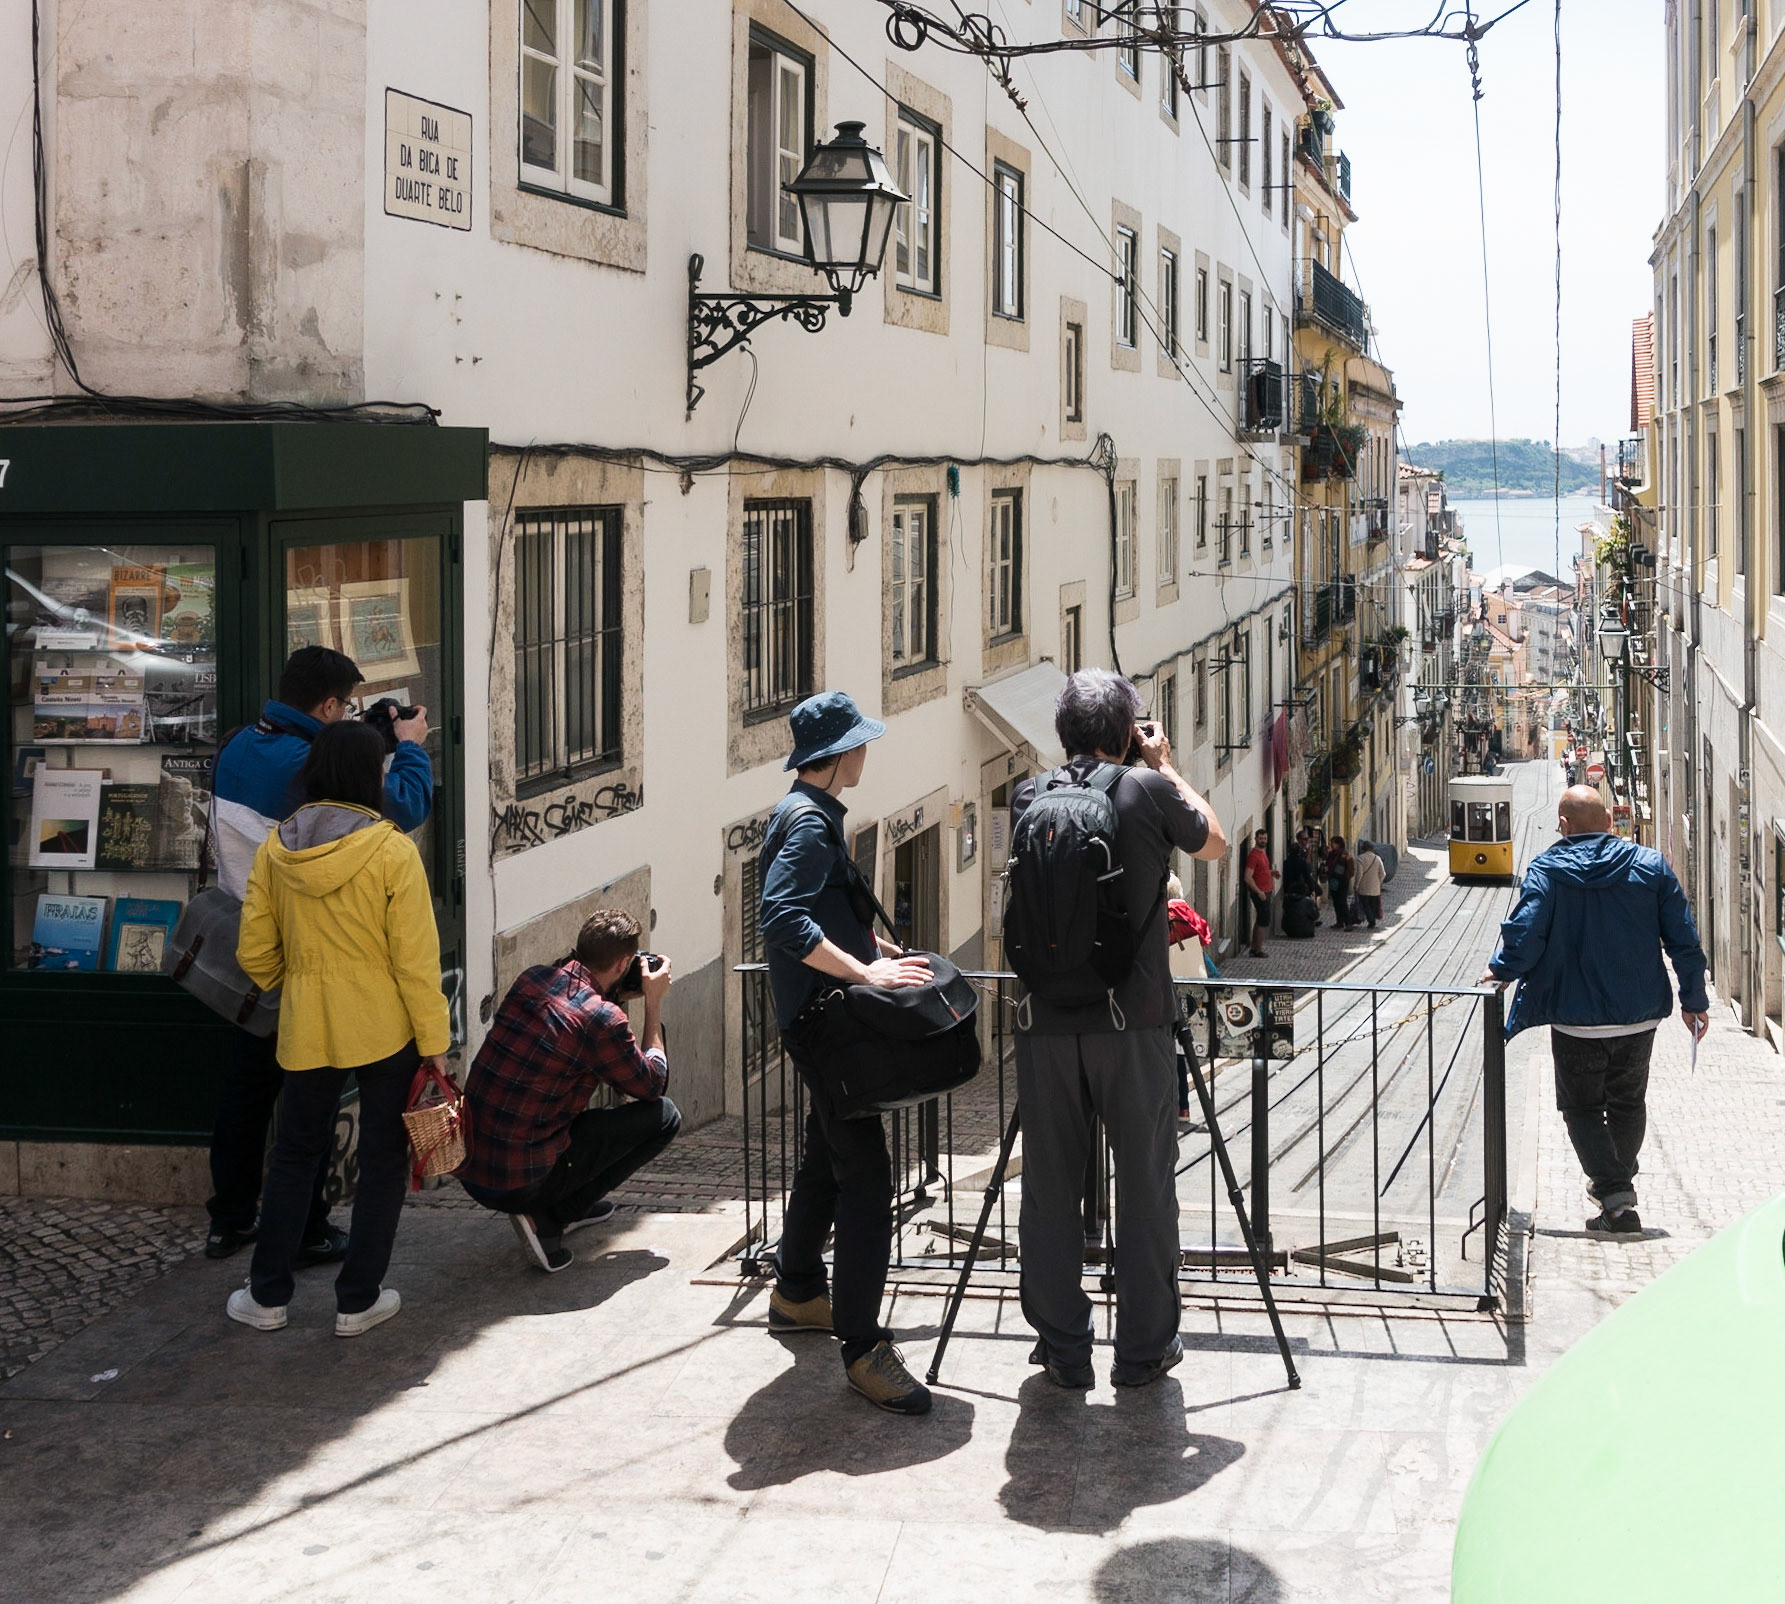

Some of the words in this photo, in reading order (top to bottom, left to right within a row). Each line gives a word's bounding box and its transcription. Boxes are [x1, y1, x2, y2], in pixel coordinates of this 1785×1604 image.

[421, 116, 439, 143] RUA
[400, 144, 413, 169] DA
[419, 149, 440, 176] BICA
[447, 156, 459, 180] DE
[395, 177, 432, 207] DUARTE
[438, 187, 463, 214] BELO
[114, 570, 151, 582] BIZARRE
[164, 758, 201, 769] ANTIGA
[43, 903, 98, 921] PRAIAS
